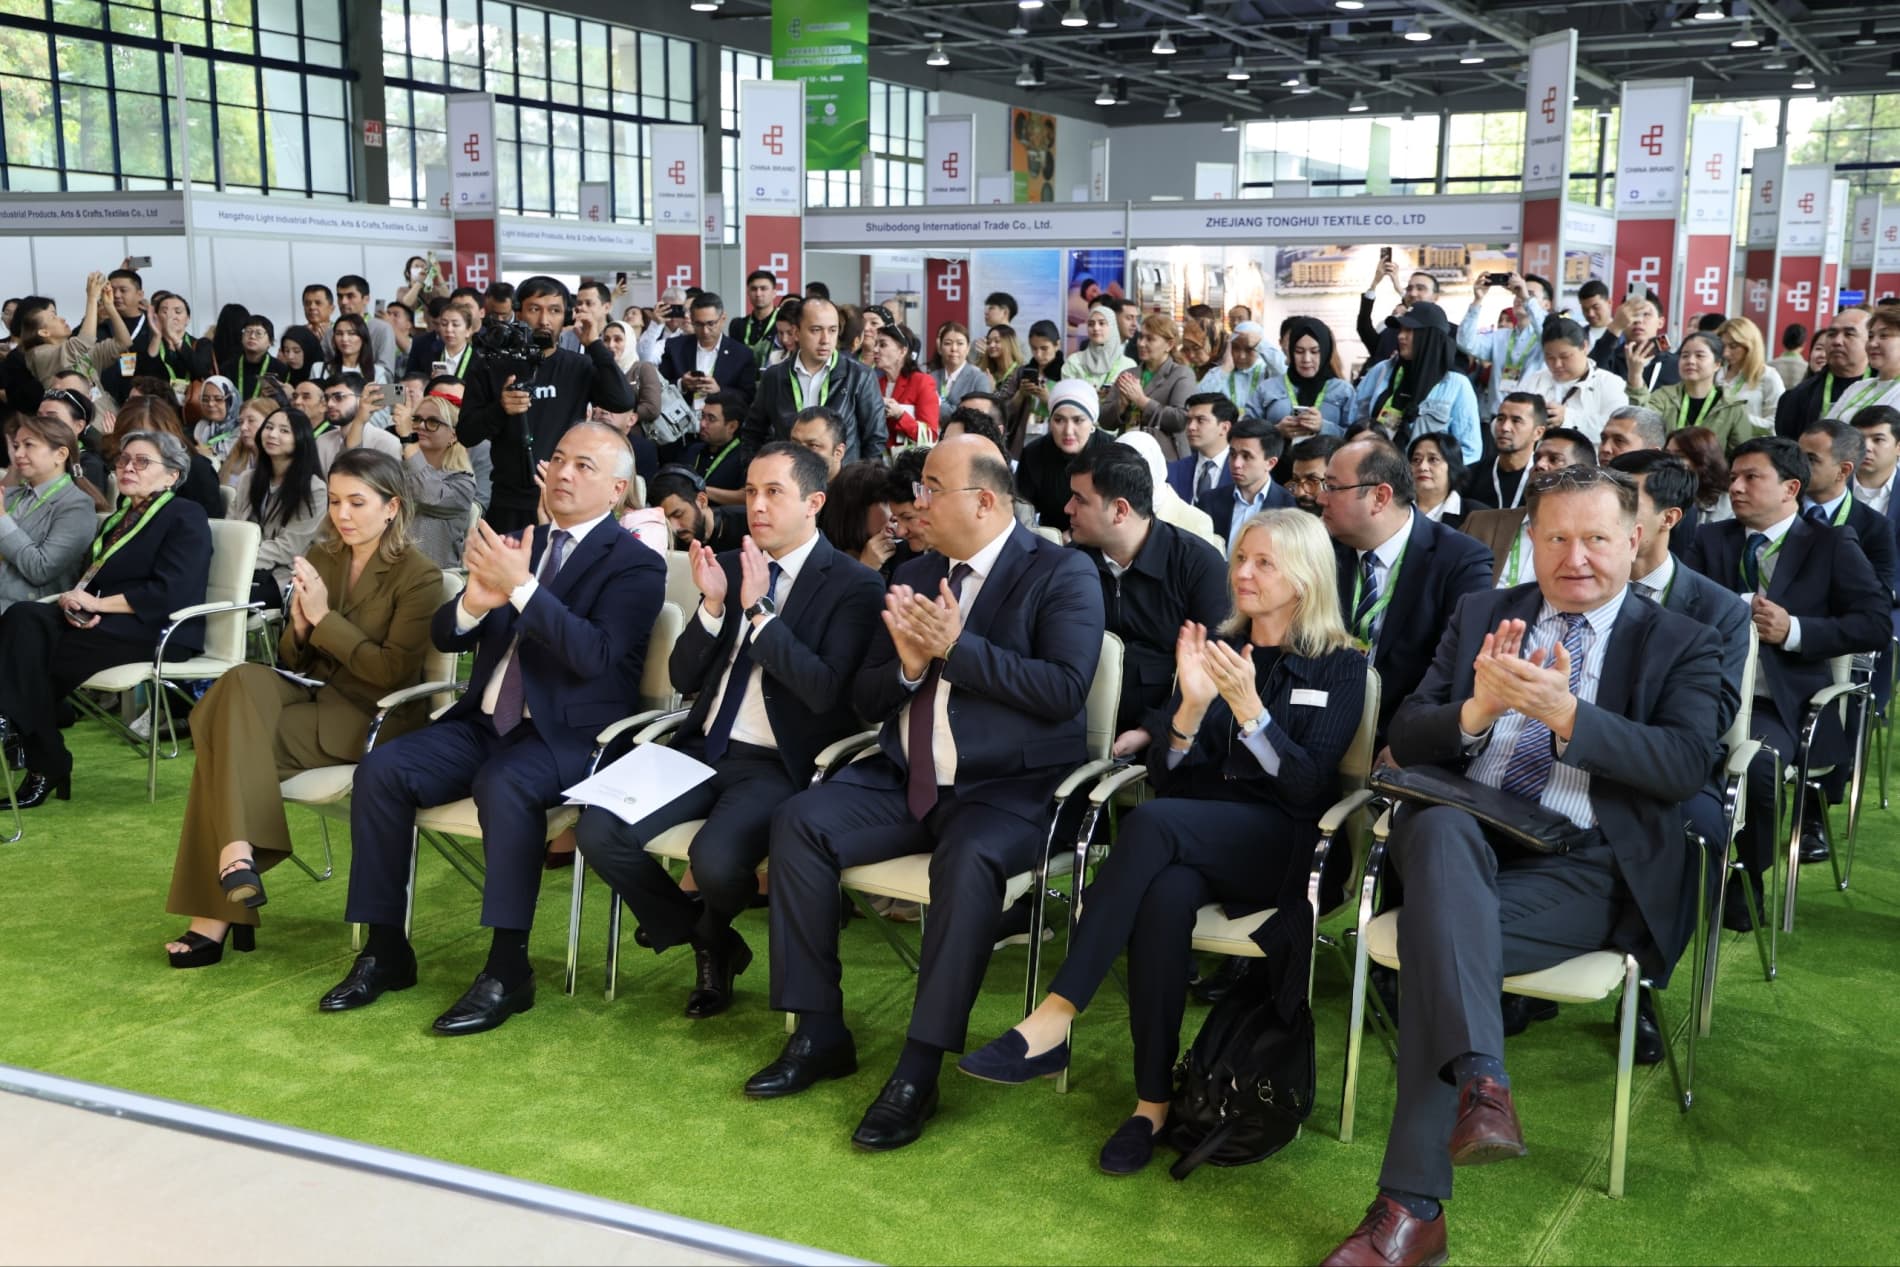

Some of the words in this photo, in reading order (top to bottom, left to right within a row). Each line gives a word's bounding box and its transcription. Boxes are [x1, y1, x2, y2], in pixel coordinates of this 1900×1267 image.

[1648, 165, 1675, 173] BRAND
[0, 209, 26, 218] ndustrial
[218, 210, 254, 222] Hangzhou
[256, 213, 274, 223] Light
[865, 222, 921, 234] Shuibodong
[922, 220, 981, 232] International
[983, 220, 1010, 231] Trade
[1205, 216, 1264, 228] ZHEJIANG
[1266, 216, 1319, 227] TONGHUI
[1322, 215, 1371, 226] TEXTILE
[1402, 213, 1426, 225] LTD
